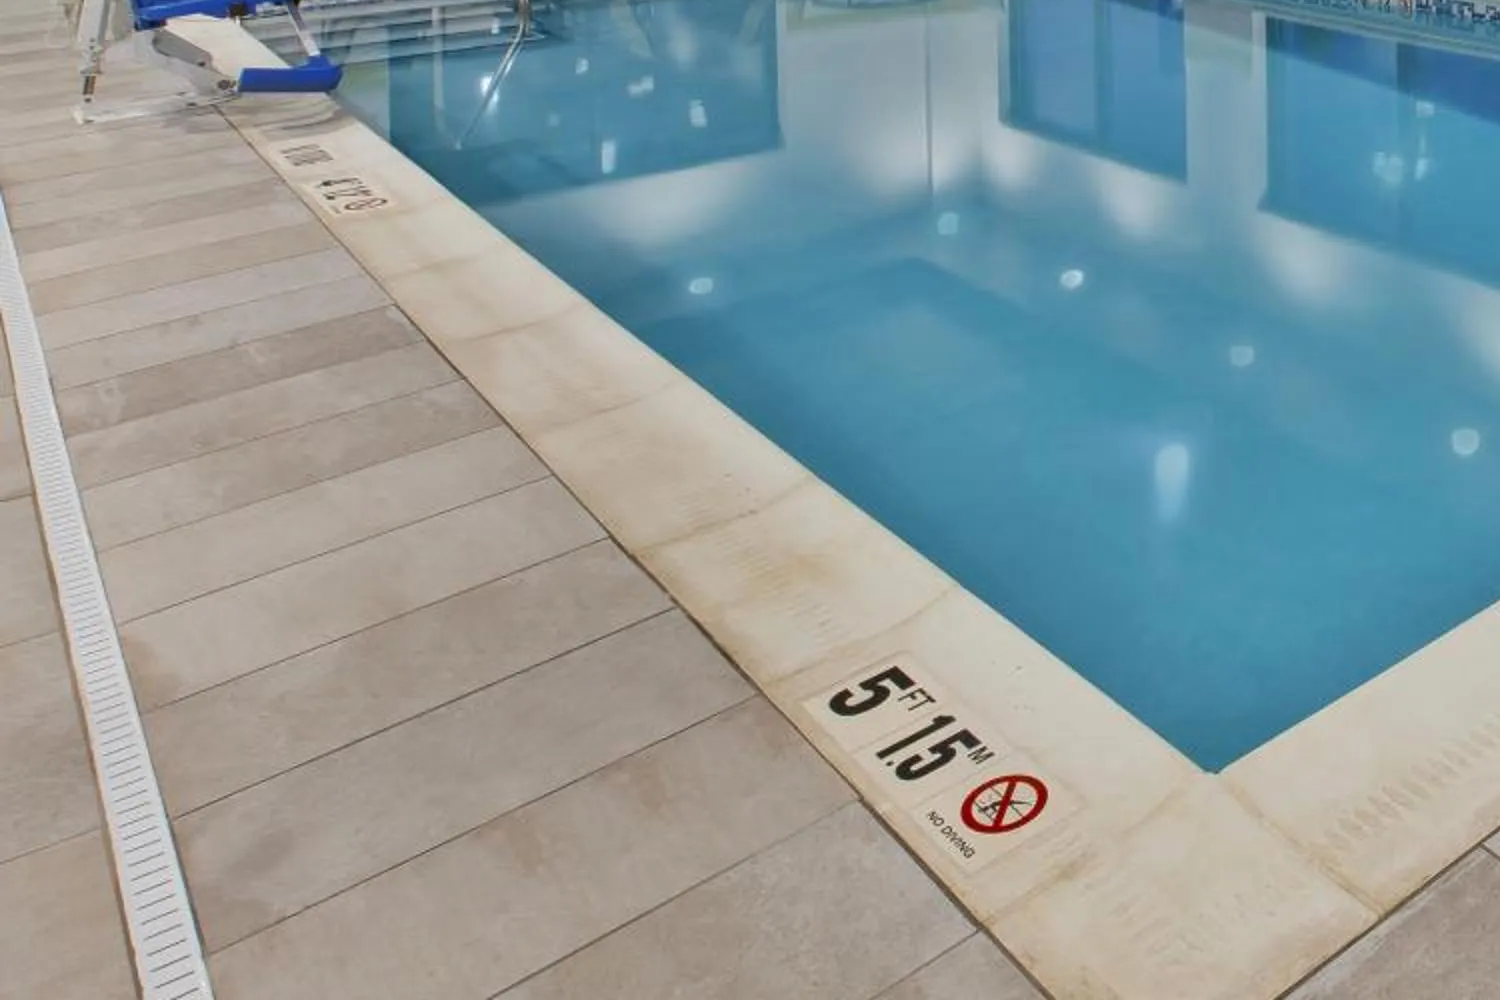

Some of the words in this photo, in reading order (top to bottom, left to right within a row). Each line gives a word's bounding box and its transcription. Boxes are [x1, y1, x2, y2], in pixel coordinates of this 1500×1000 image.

[875, 714, 983, 781] 1.5
[926, 811, 945, 827] NO
[940, 825, 976, 859] DIVING
